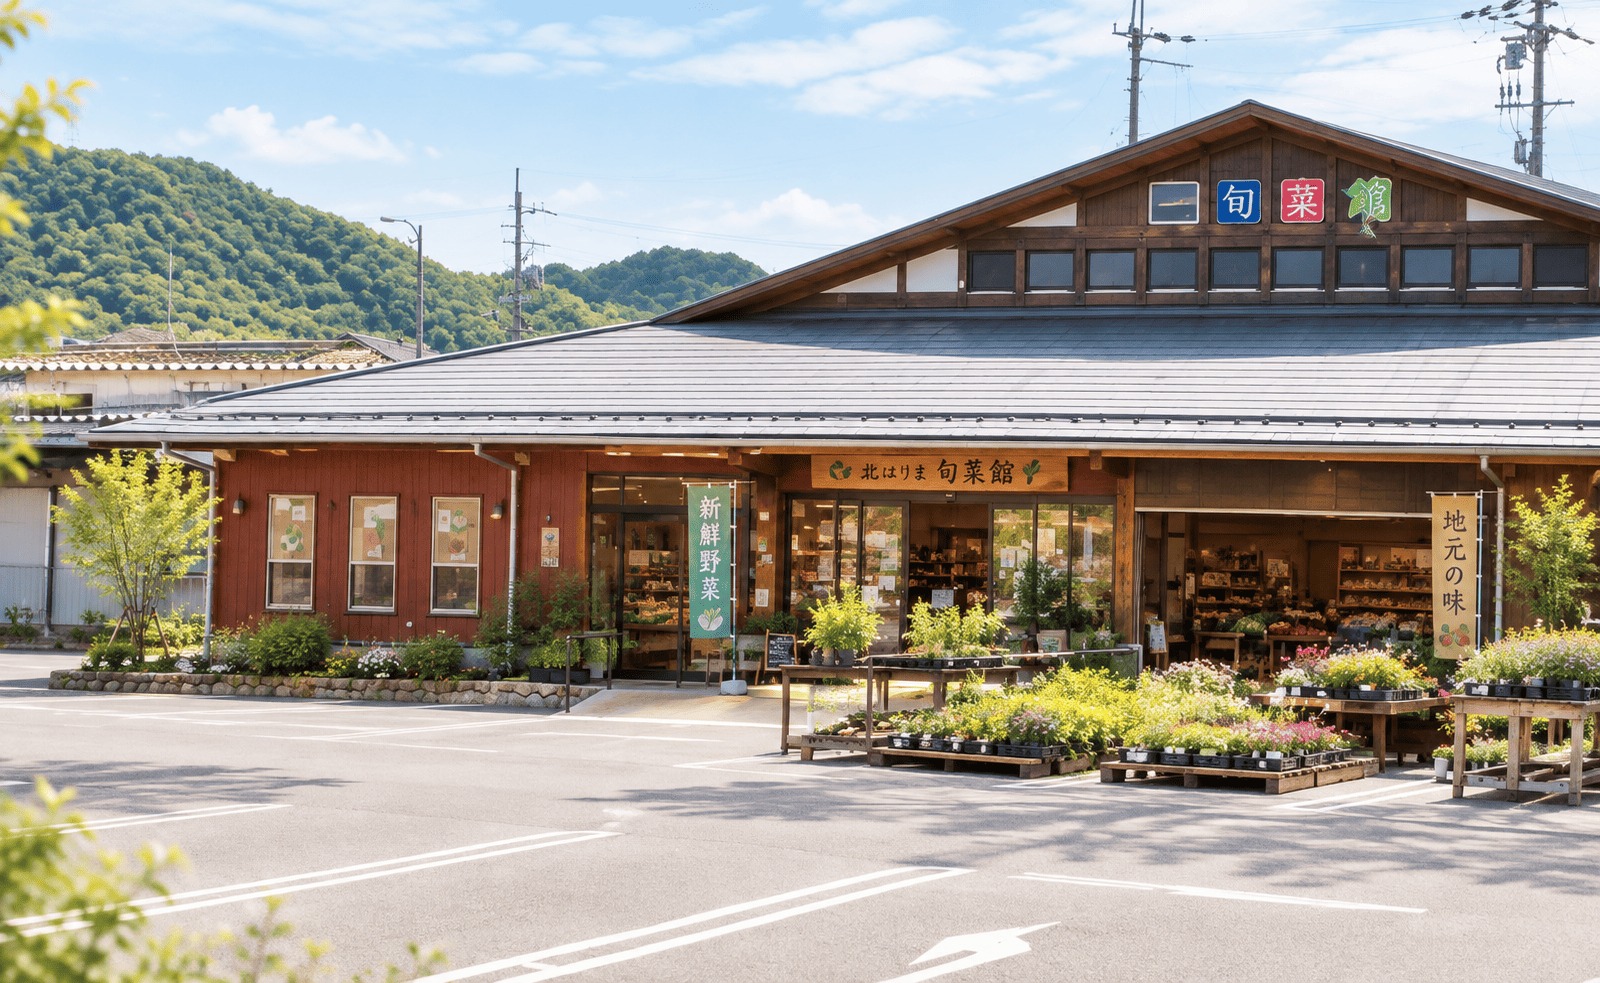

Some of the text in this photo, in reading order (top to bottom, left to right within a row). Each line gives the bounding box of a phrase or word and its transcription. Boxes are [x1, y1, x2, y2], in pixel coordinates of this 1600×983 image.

[861, 458, 1015, 485] 北はりま 旬菜館
[699, 496, 721, 601] 新鮮野菜
[1442, 509, 1468, 616] 地元の味
